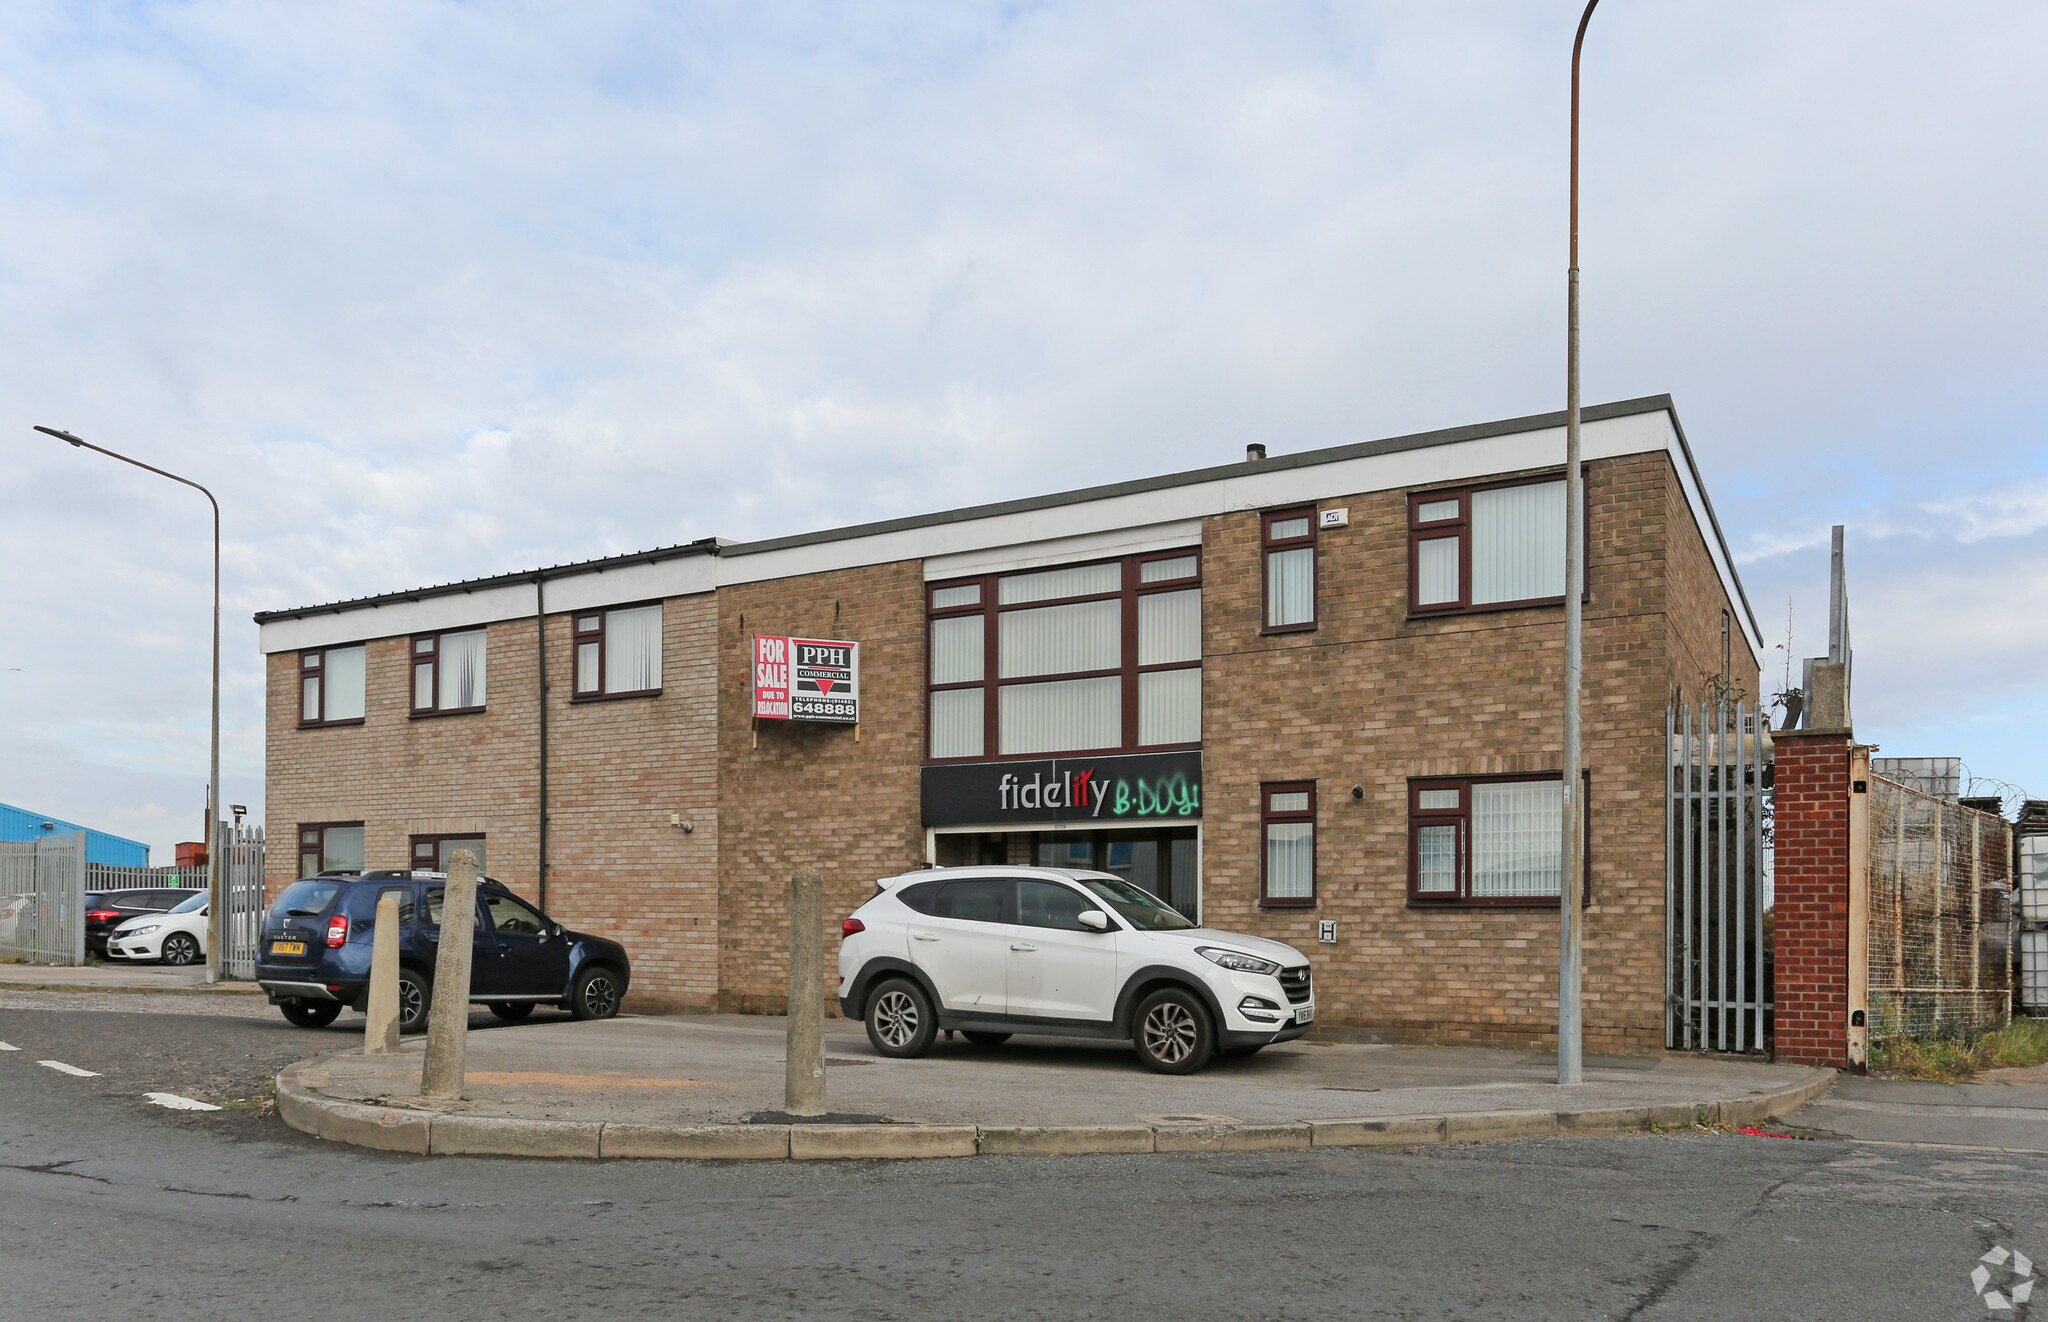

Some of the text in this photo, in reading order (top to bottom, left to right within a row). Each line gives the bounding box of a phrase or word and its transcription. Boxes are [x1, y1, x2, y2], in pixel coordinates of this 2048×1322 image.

[759, 638, 785, 663] FOR
[802, 646, 845, 666] PPH
[757, 663, 787, 688] SALE
[799, 670, 849, 680] COMMERCIAL
[762, 690, 785, 700] DUE TO
[757, 700, 788, 716] RELOCATION
[793, 702, 856, 716] 648888
[998, 767, 1111, 817] fidelity
[1322, 922, 1334, 940] H
